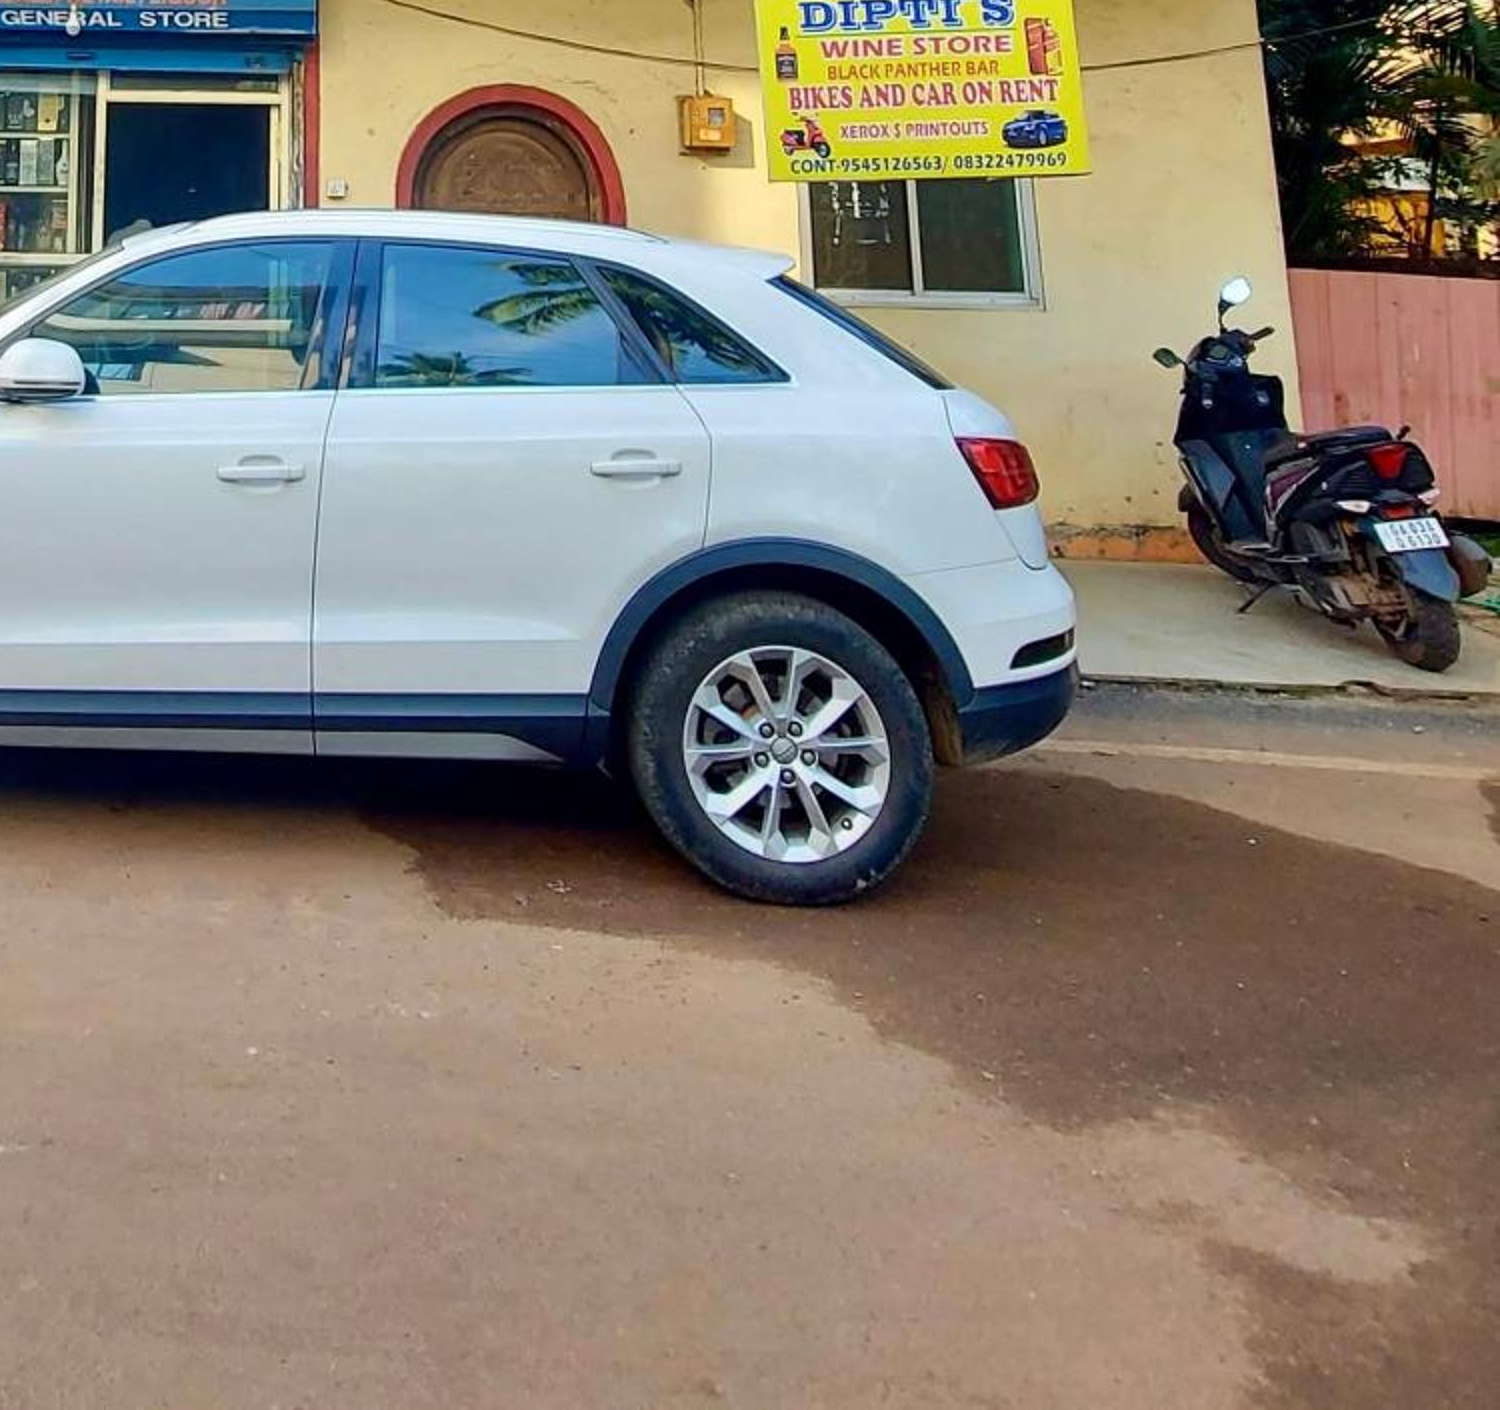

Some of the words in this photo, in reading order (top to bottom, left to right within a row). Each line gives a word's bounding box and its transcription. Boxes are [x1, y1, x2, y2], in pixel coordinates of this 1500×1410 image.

[140, 11, 228, 27] STORE
[821, 38, 903, 58] WINE
[913, 35, 1011, 56] STORE
[828, 64, 880, 80] BLACK
[886, 61, 961, 78] PANTHER
[966, 60, 999, 75] BAR
[790, 86, 852, 109] BIKES
[860, 84, 906, 107] AND
[912, 82, 957, 106] CAR
[963, 81, 993, 104] ON
[995, 79, 1059, 103] RENT
[840, 123, 890, 138] XEROX
[905, 121, 989, 138] PRINTOUTS
[953, 152, 1067, 170] 08322479969
